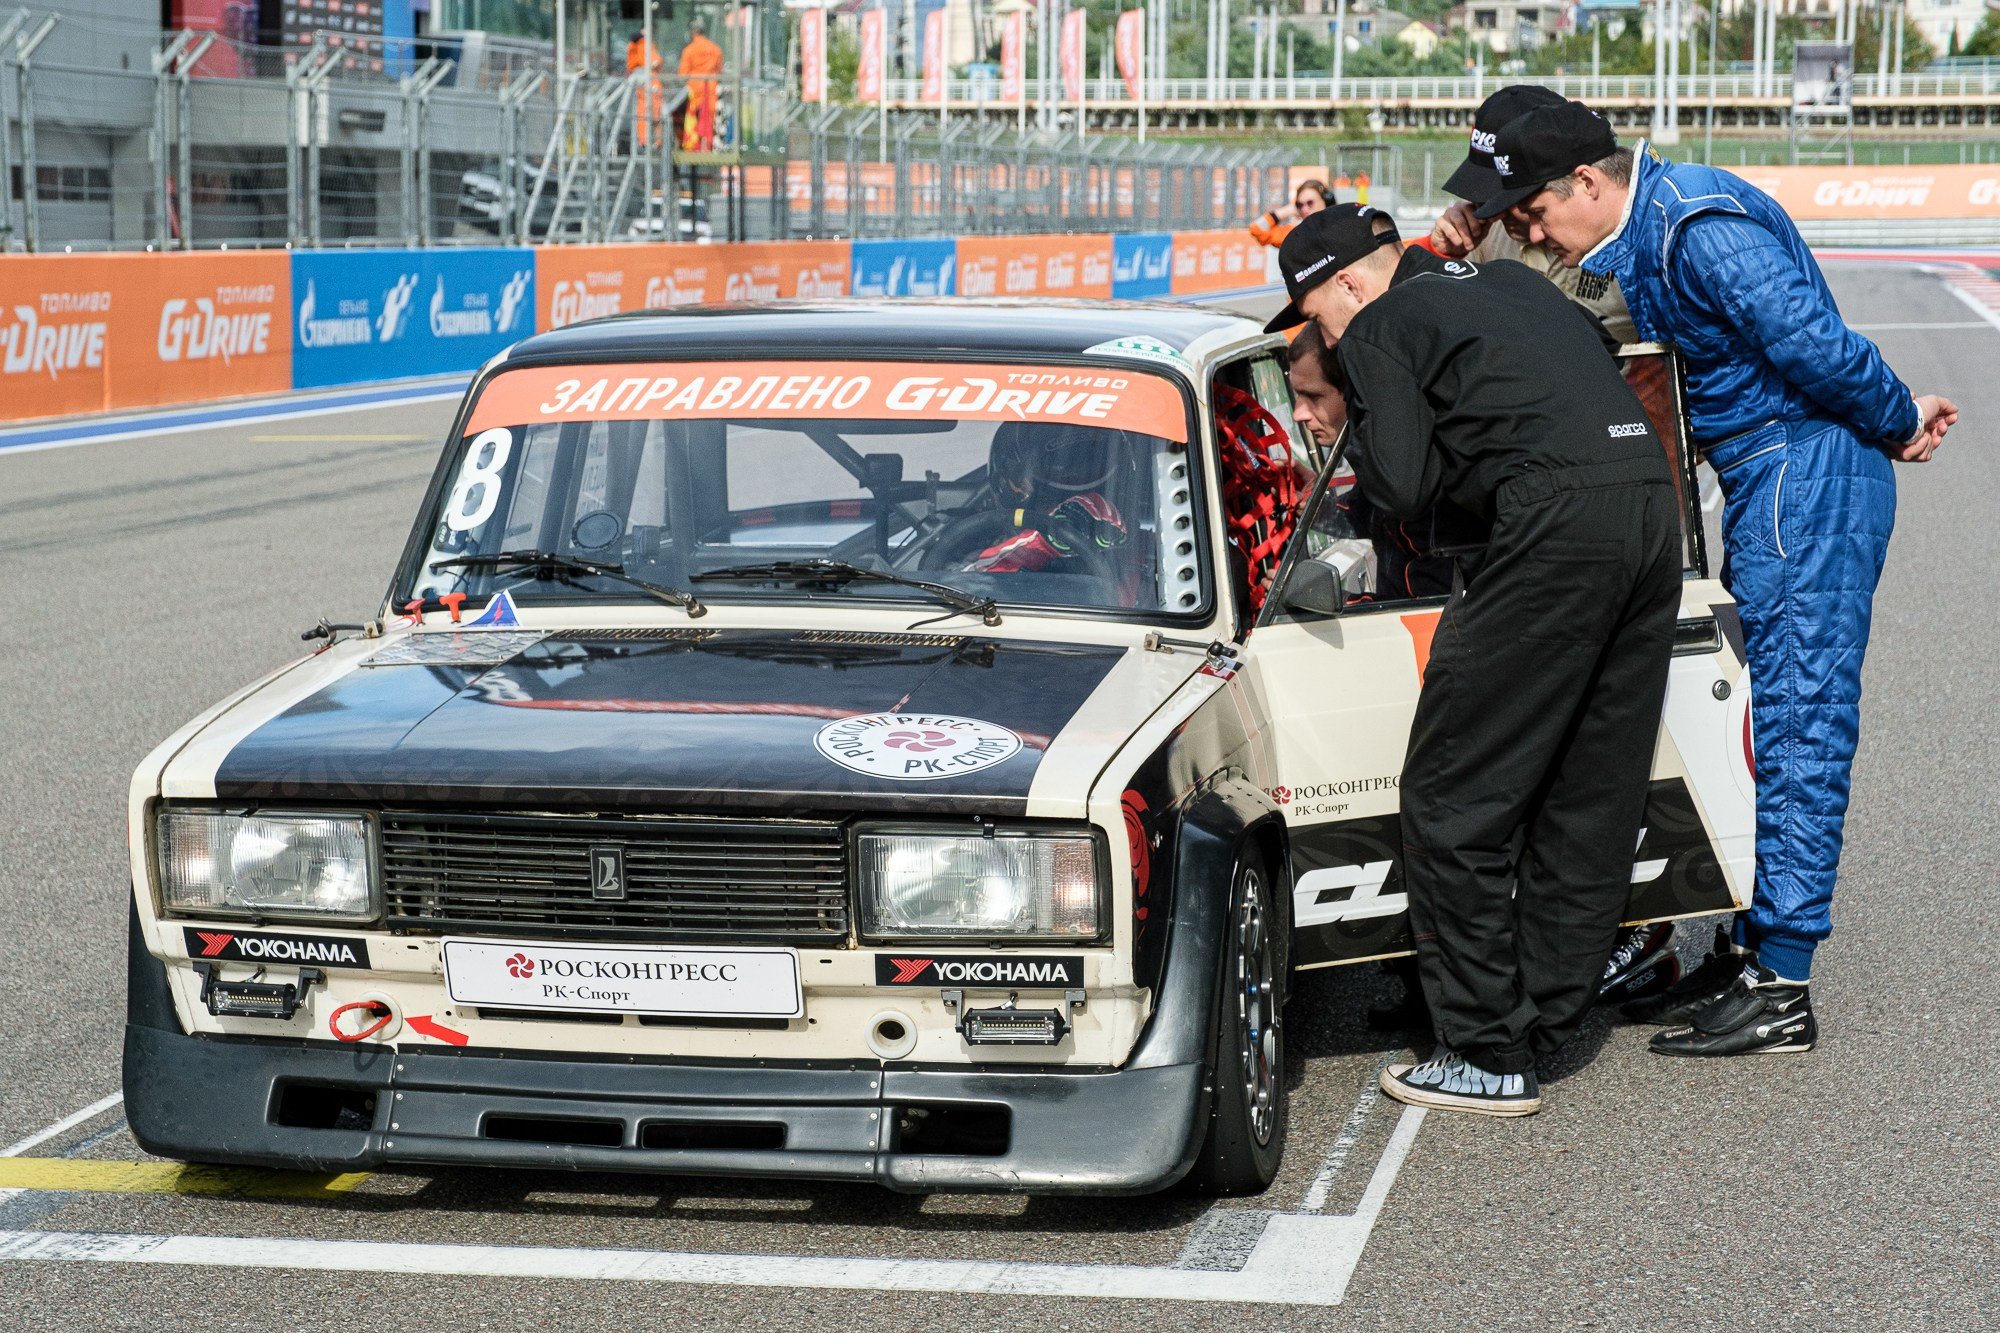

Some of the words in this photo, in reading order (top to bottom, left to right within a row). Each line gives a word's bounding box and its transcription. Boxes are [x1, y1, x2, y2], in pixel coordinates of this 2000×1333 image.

[1576, 285, 1605, 302] GROUP
[1579, 276, 1610, 293] RACING
[0, 304, 107, 382] -DRIVE
[1007, 373, 1129, 390] ТОПЛИВО
[539, 376, 871, 415] ЗАПРАВЛЕНО
[1608, 423, 1647, 437] sparco
[447, 427, 512, 531] 8
[828, 716, 974, 759] РОСКОНГРЕСС
[904, 737, 1009, 774] РК-СПОРТ
[1294, 775, 1400, 800] РОСКОНГРЕС
[1294, 803, 1350, 816] РК-Спорт
[233, 937, 357, 963] YOKOHAMA
[539, 958, 738, 983] РОСКОНГРЕСС
[933, 962, 1069, 982] YOKOHAMA
[542, 984, 631, 1005] РК-Спорт
